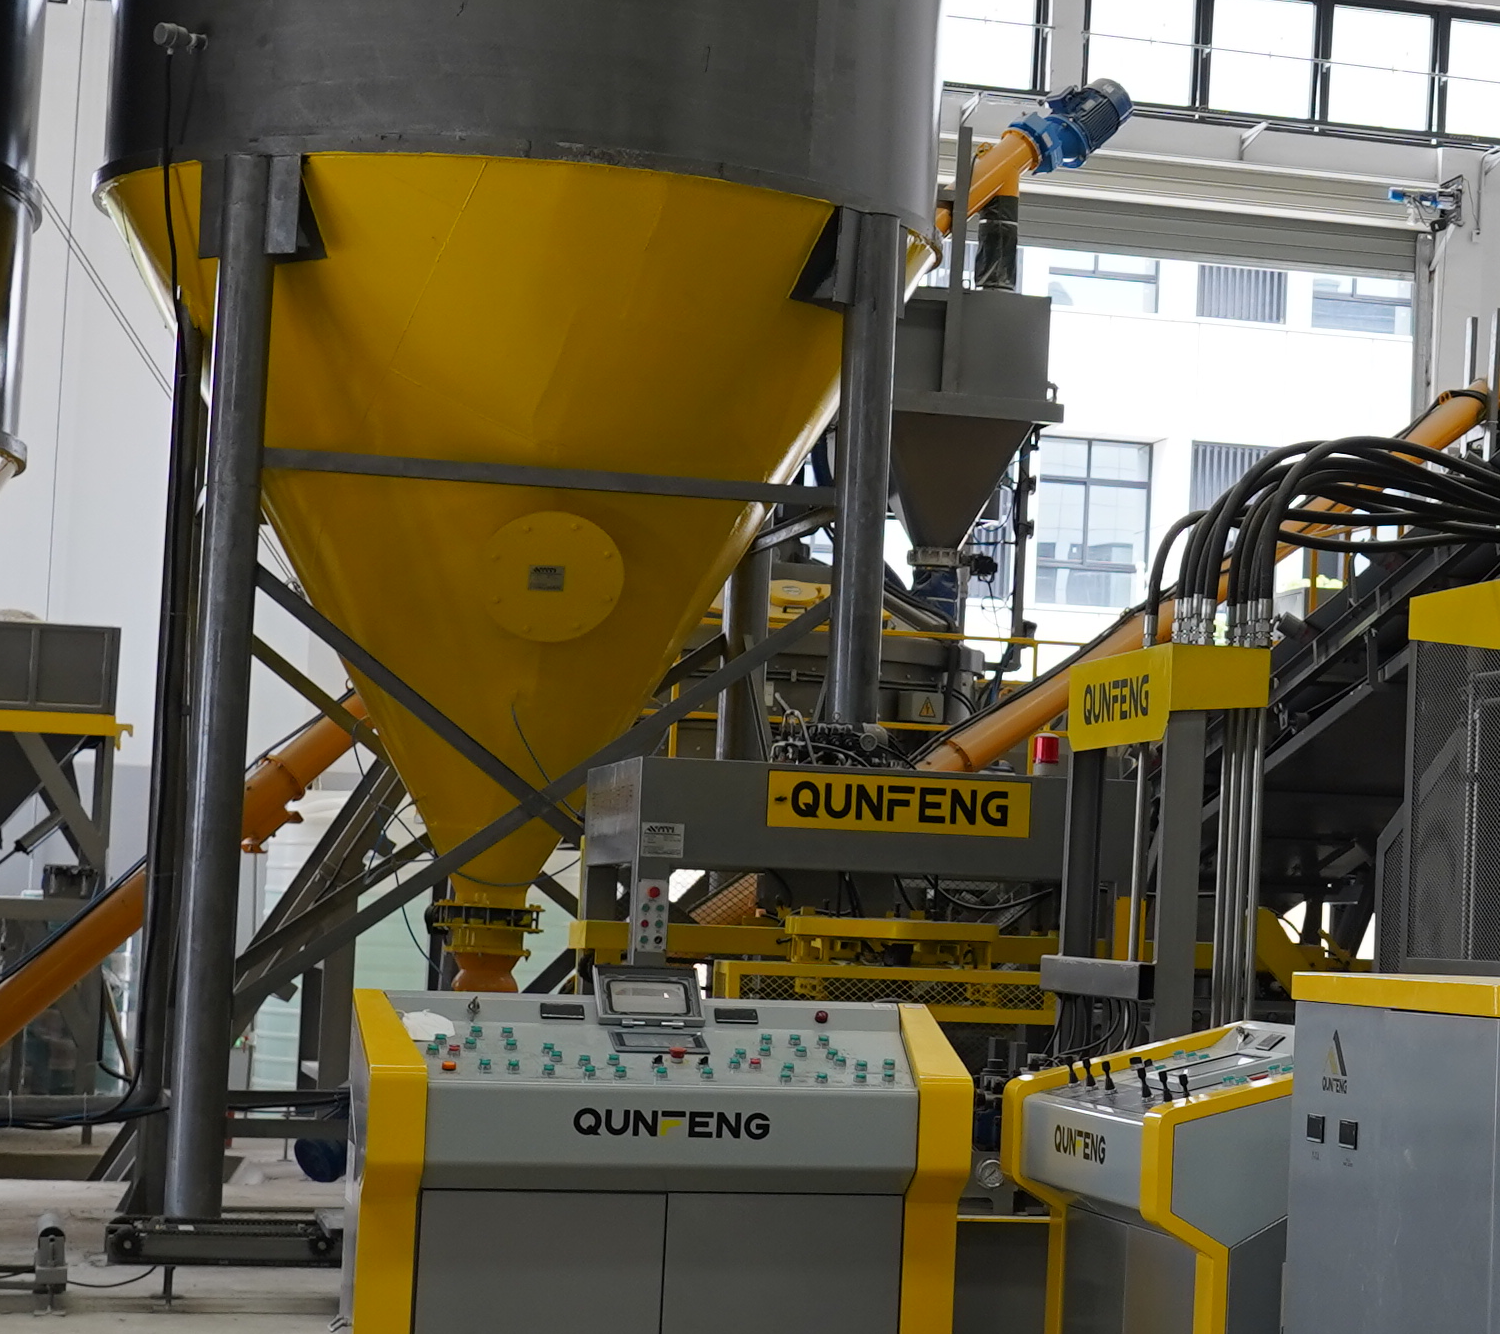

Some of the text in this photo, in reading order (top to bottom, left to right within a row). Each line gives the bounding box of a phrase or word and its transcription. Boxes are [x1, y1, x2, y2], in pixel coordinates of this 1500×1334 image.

[1083, 673, 1150, 726] QUNFENG
[790, 780, 1009, 828] QUNFENG
[573, 1107, 771, 1140] QUNFENG
[1054, 1124, 1106, 1165] QUNFENG
